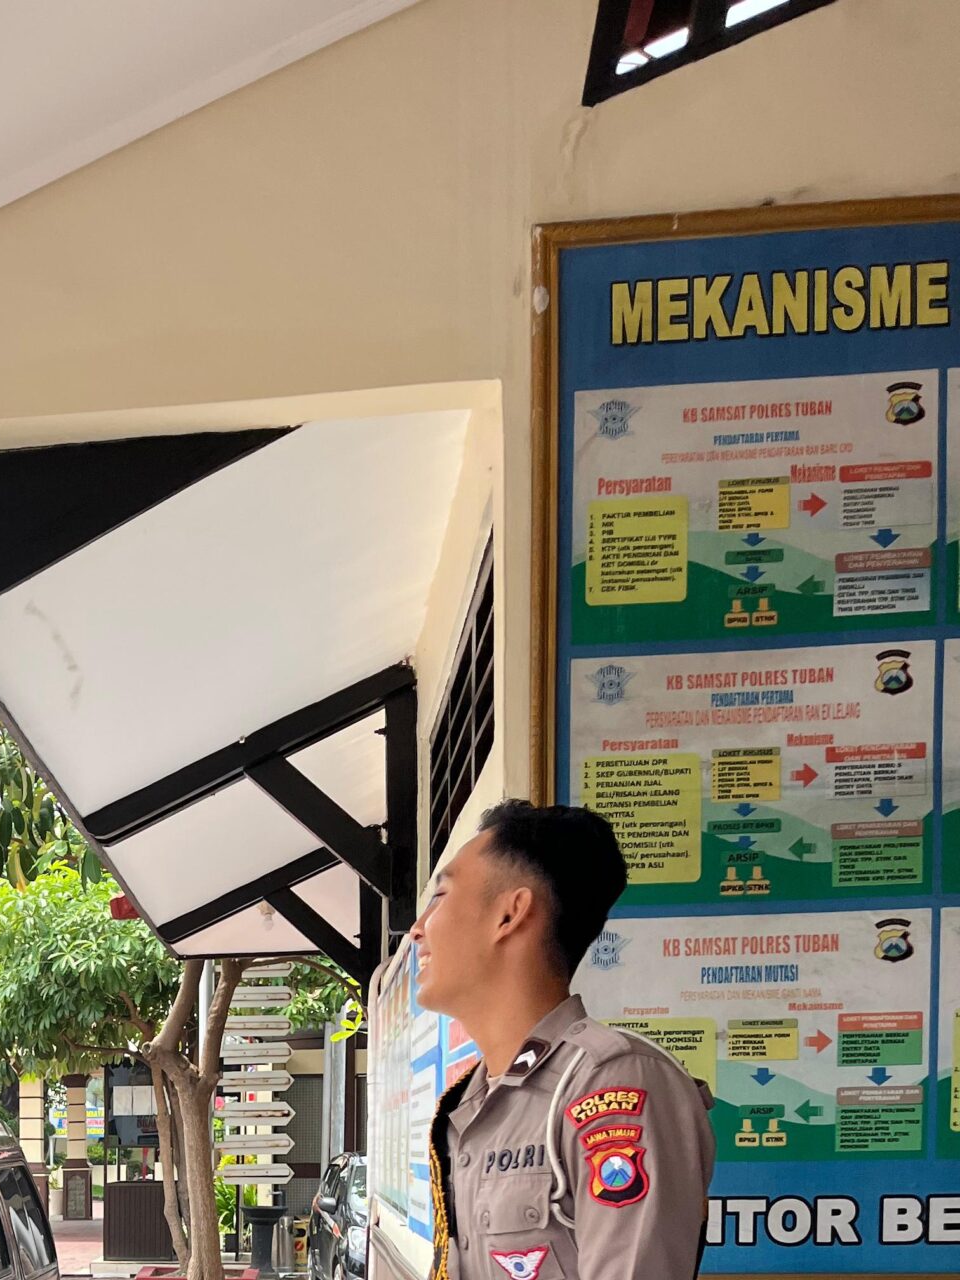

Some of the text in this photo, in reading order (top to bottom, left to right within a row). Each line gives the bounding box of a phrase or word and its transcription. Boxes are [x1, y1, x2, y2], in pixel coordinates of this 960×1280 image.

[611, 262, 950, 345] MEKANISME
[682, 400, 832, 423] KB SAMSAT POLRES TUBAN
[790, 463, 836, 484] Mekanisme
[598, 476, 672, 496] Persyaratan
[667, 667, 834, 690] KB SAMSAT POLRES TUBAN
[711, 691, 759, 707] PENDAFTARAN
[833, 702, 860, 720] LELANG
[602, 738, 679, 752] Persyaratan
[787, 733, 834, 746] Mekanisme
[596, 760, 650, 768] PERSETUJUAN
[616, 768, 692, 778] GUBERNUR/BUPATI
[649, 789, 680, 797] LELANG
[728, 852, 759, 862] ARSIP
[663, 933, 839, 957] KB SAMSAT POLRES TUBAN
[701, 964, 799, 984] PENDAFTARAN MUTASI
[623, 1006, 669, 1016] Persyaratan
[788, 1002, 843, 1011] Mekanisme
[570, 1091, 640, 1118] POLRES
[578, 1101, 634, 1121] TUBAN
[586, 1128, 636, 1145] JAWA TIMUR
[485, 1144, 545, 1174] POLRI
[705, 1196, 861, 1245] TOR
